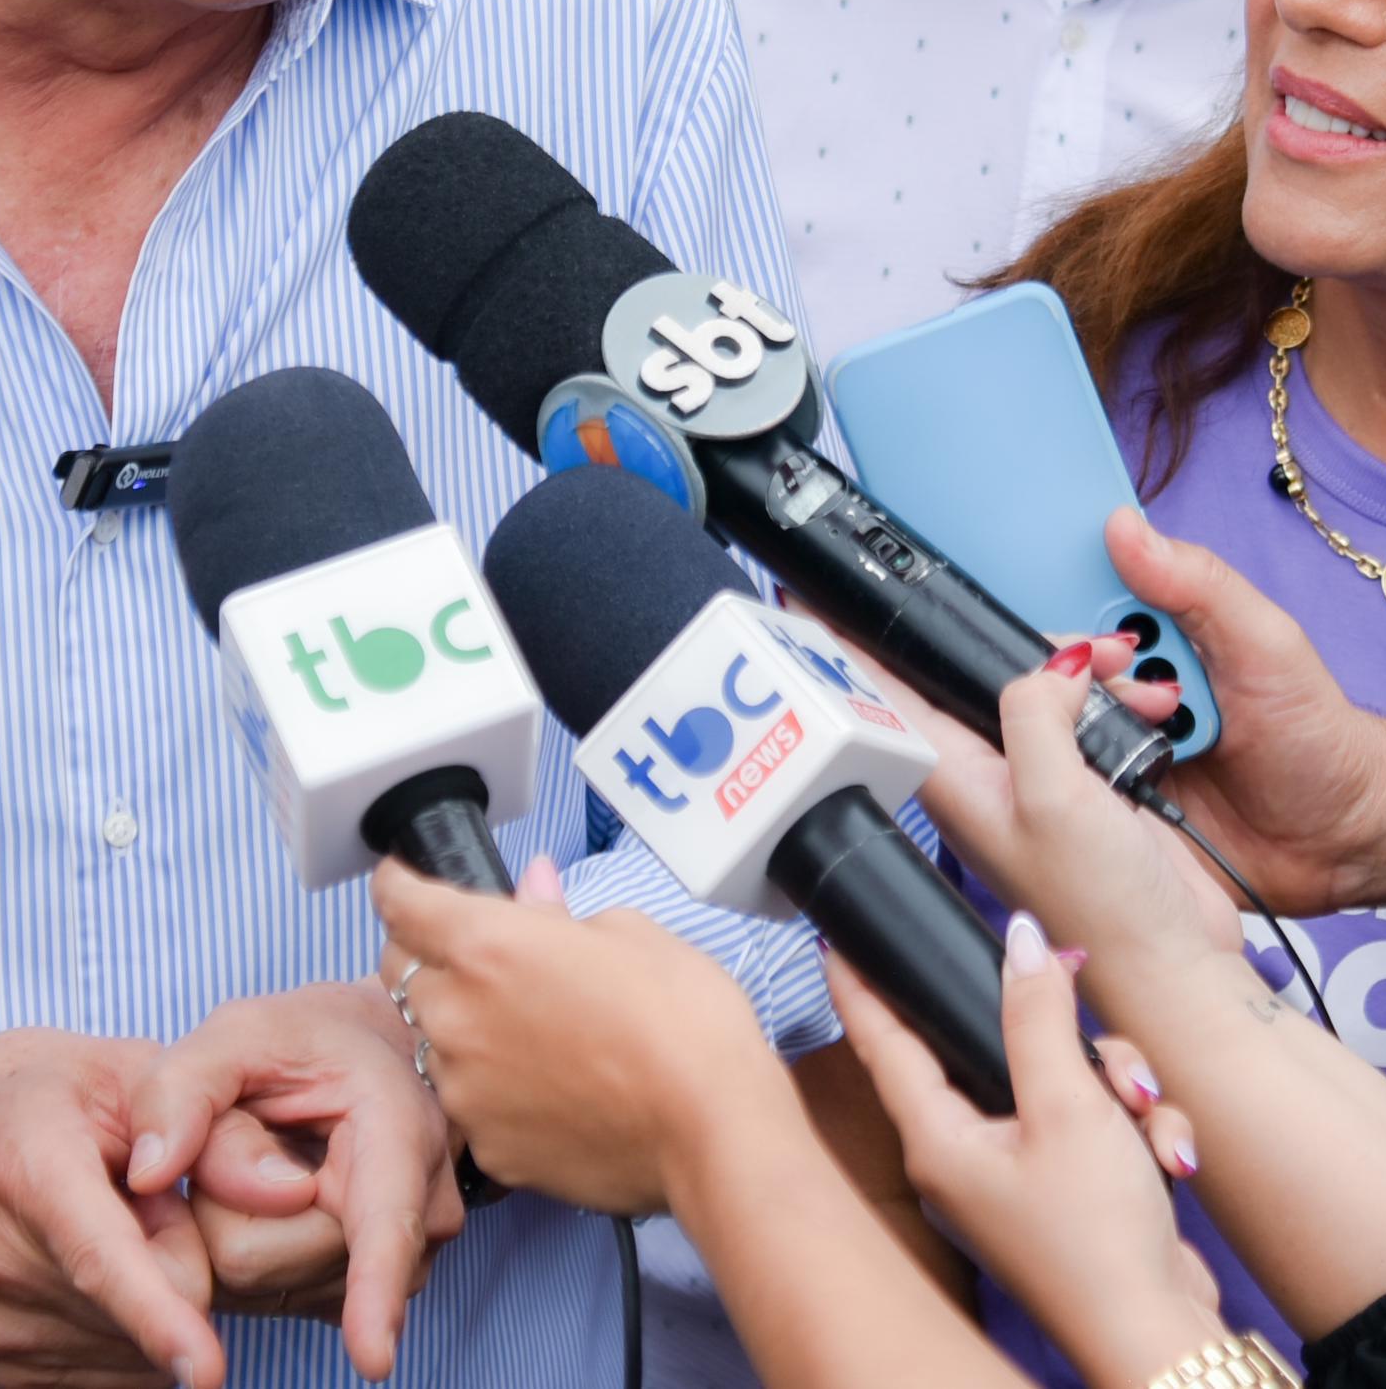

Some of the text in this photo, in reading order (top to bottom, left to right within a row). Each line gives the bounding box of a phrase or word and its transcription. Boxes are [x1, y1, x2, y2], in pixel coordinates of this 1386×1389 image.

[641, 281, 797, 414] sbt
[282, 598, 493, 713] tbc
[613, 652, 783, 814] tbc
[722, 723, 798, 810] news
